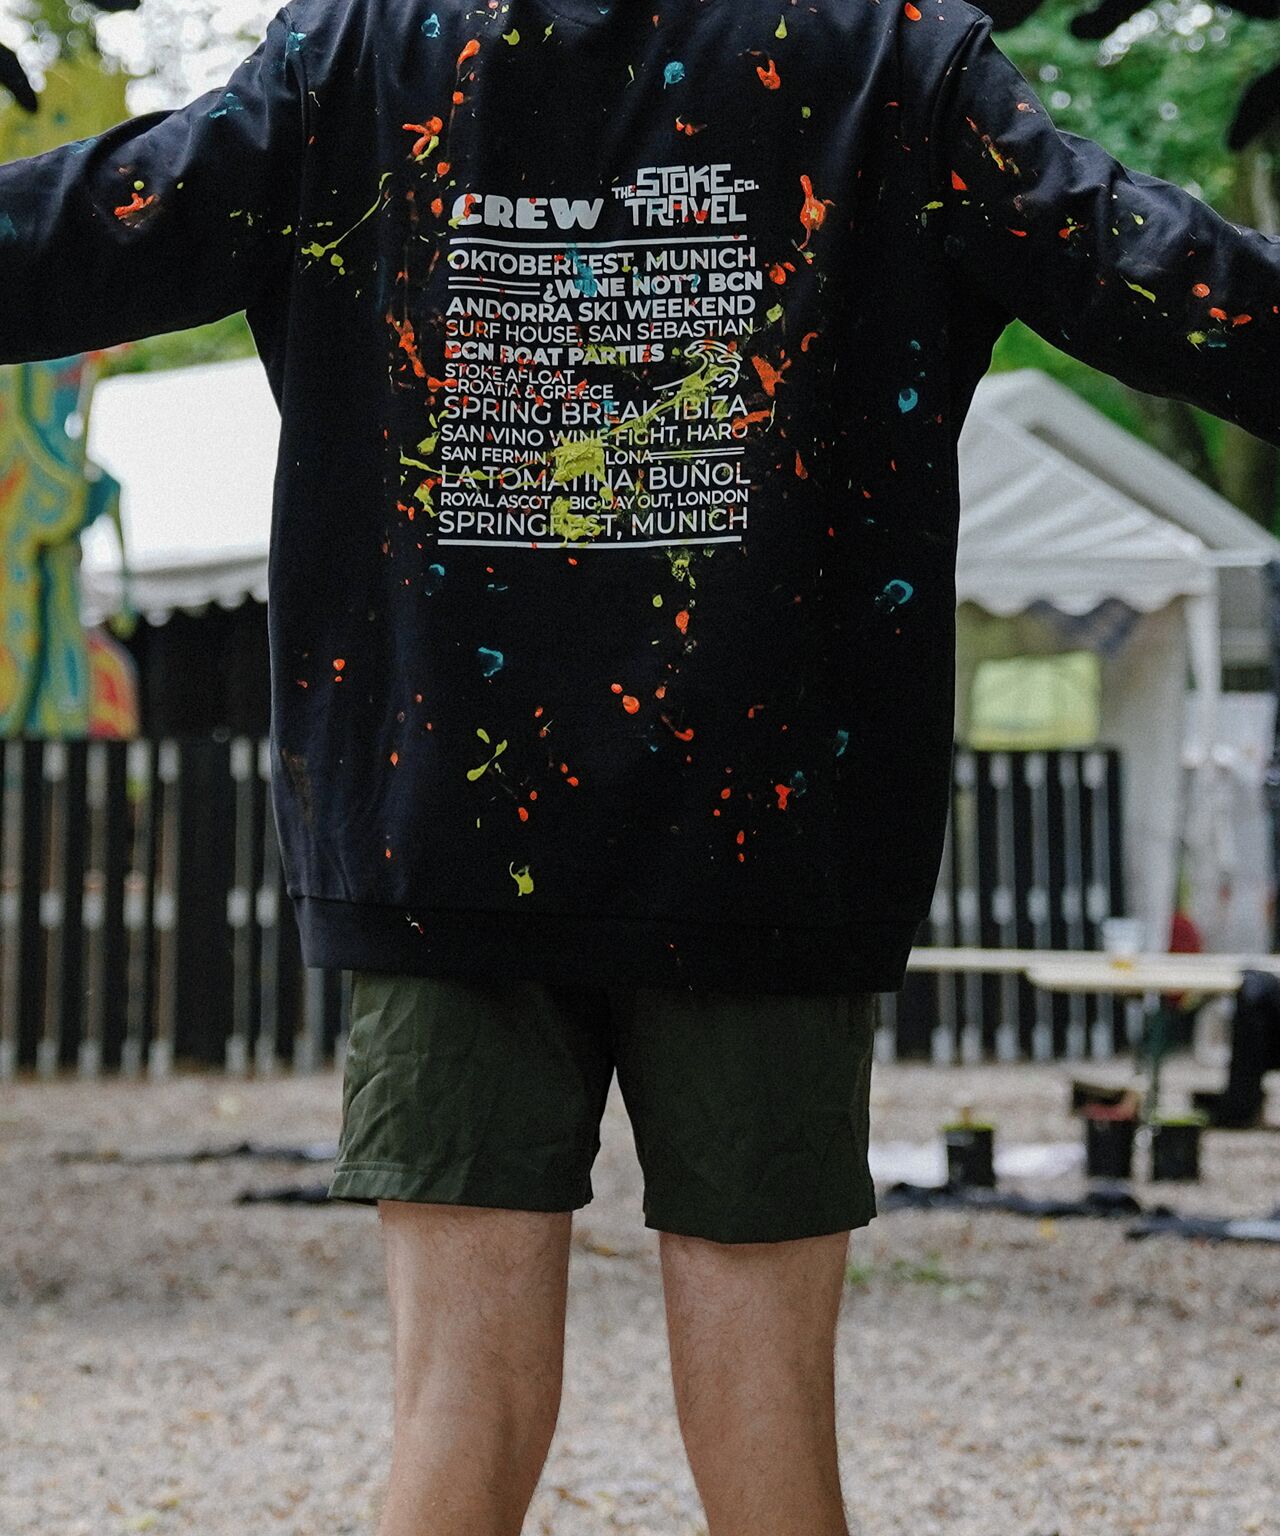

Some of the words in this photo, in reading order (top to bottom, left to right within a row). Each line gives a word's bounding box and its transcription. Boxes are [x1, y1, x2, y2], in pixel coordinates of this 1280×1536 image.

[611, 185, 636, 199] THE
[636, 164, 733, 196] STOKE
[451, 193, 604, 230] CREW
[624, 195, 747, 227] TRAVEL
[449, 249, 638, 275] OKTOBERFEST,
[646, 247, 756, 272] MUNICH
[632, 273, 701, 295] NOT?
[708, 271, 763, 293] BCN
[445, 297, 573, 322] ANDORRA
[578, 301, 617, 322] SKI
[624, 295, 756, 320] WEEKEND
[445, 319, 500, 339] SURF
[588, 324, 631, 343] SAN
[637, 318, 754, 340] SEBASTIAN
[445, 341, 494, 361] BCN
[500, 345, 563, 366] BOAT
[569, 343, 665, 366] PARTIES
[445, 363, 502, 381] STOKE
[505, 367, 575, 384] AFLOAT
[524, 385, 536, 399] &
[540, 384, 614, 400] GREECE
[444, 395, 552, 425] SPRING
[562, 399, 666, 426] BREAK,
[674, 394, 748, 421] IBIZA
[441, 424, 484, 444] SAN
[490, 426, 544, 446] VINO
[615, 425, 681, 447] FIGHT,
[687, 423, 748, 443] HARO
[441, 446, 476, 461] SAN
[482, 448, 551, 466] FERMIN,
[441, 464, 477, 489] LA
[649, 459, 751, 490] BUÑOL
[440, 492, 494, 507] ROYAL
[496, 495, 552, 510] ASCOT
[570, 495, 597, 510] BIG
[638, 493, 673, 510] OUT,
[677, 488, 749, 507] LONDON
[438, 510, 623, 540] SPRINGFST,
[632, 507, 748, 536] MUNICH
